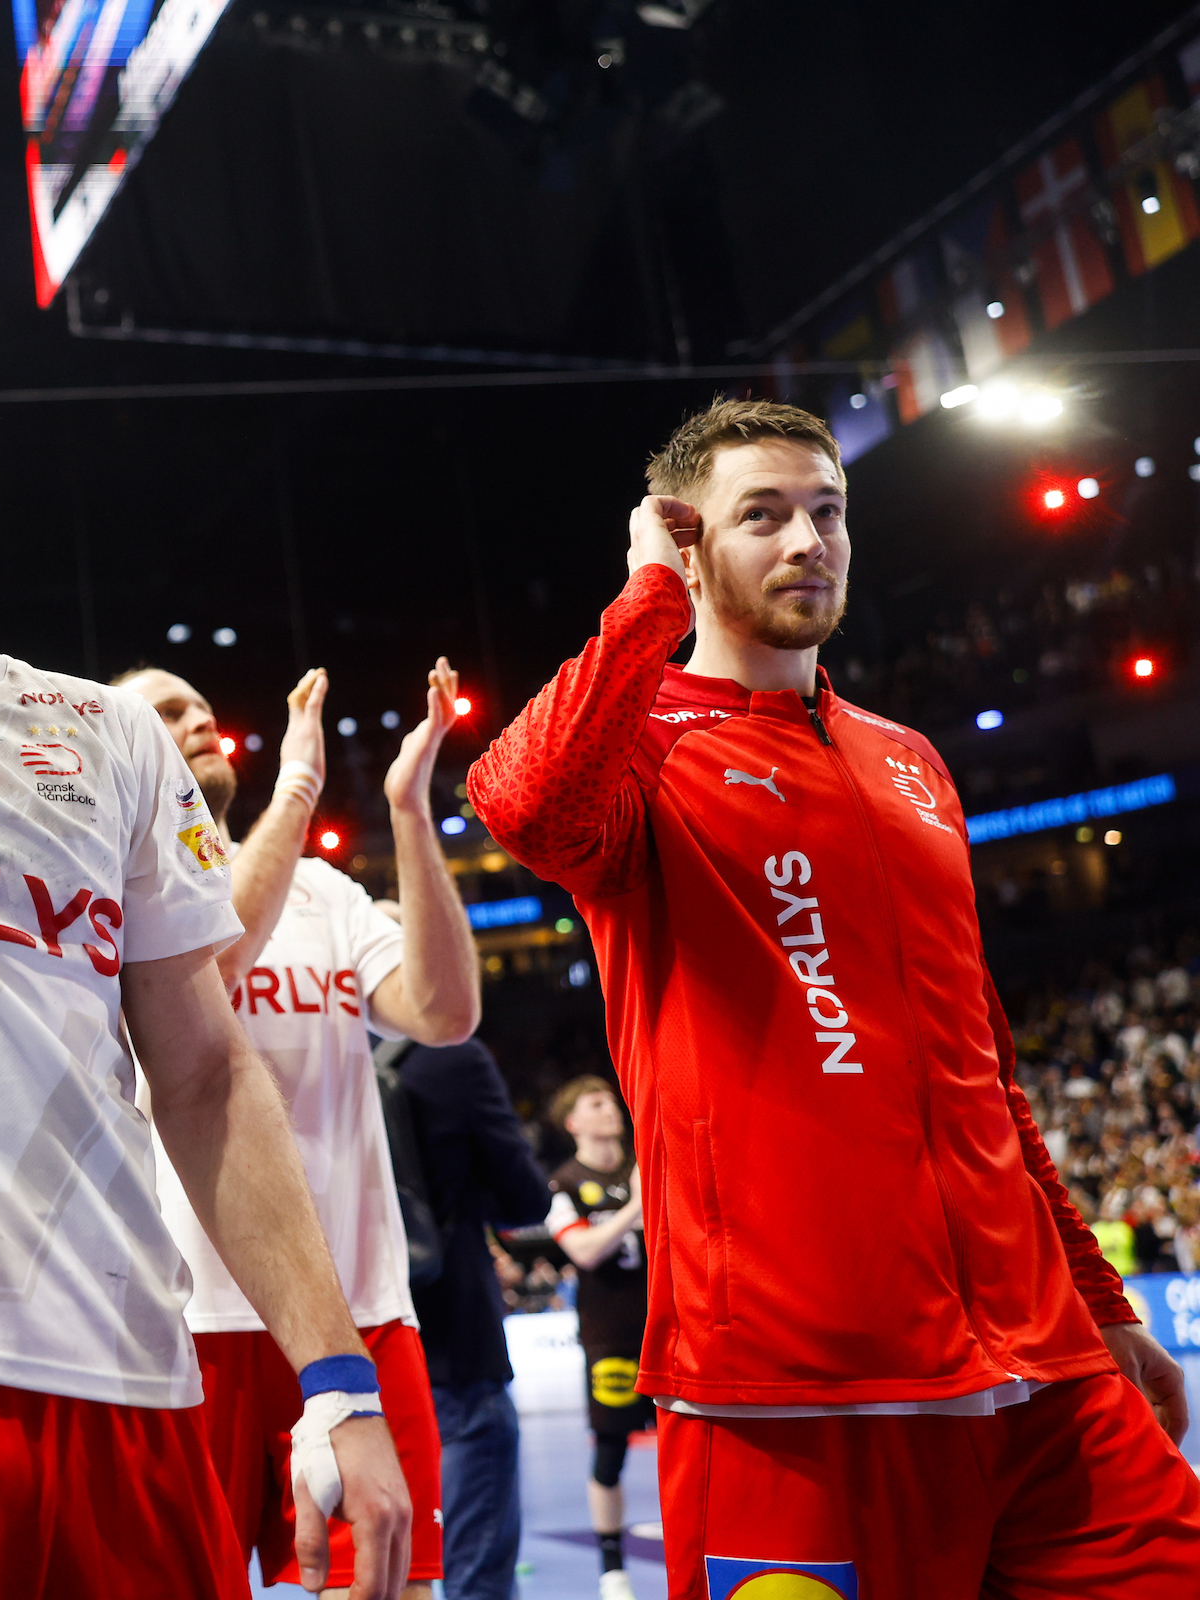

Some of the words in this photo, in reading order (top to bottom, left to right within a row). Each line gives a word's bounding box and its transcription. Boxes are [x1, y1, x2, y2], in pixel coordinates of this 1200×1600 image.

[36, 782, 75, 792] Dansk
[764, 850, 864, 1074] NORLYS
[231, 966, 361, 1018] RLYS
